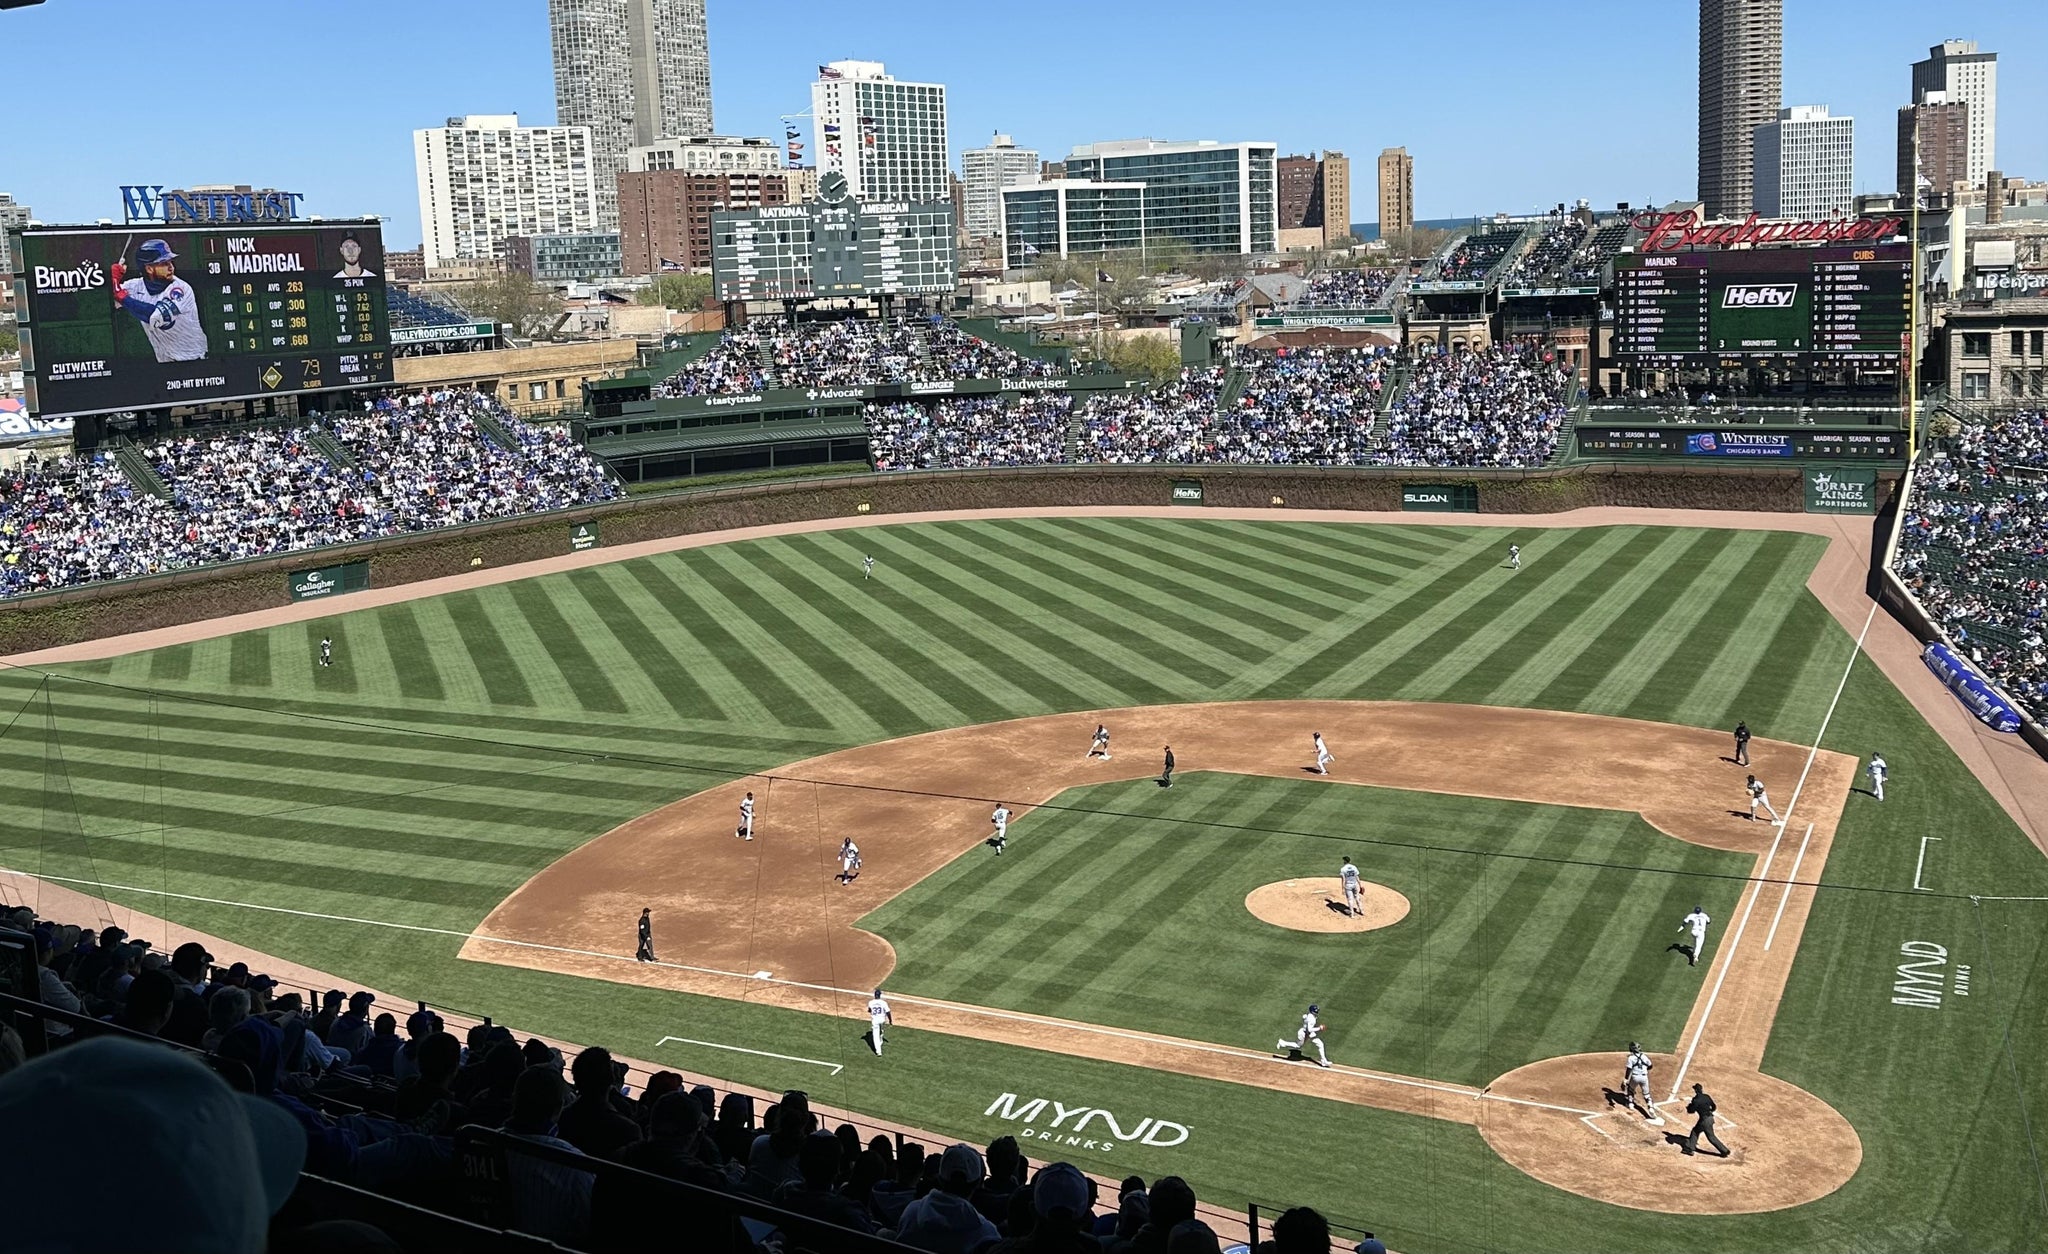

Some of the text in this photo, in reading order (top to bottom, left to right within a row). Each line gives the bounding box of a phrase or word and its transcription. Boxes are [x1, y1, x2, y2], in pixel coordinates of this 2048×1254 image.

[119, 186, 304, 221] WINTRUST
[860, 203, 909, 214] AMERICAN
[760, 207, 809, 218] NATIONAL
[1632, 210, 1904, 251] Budweiser
[227, 238, 255, 252] NICK
[1853, 251, 1875, 260] CUBS
[229, 253, 304, 274] MADRIGAL
[1645, 257, 1677, 267] MARLINS
[209, 263, 220, 274] 3B
[34, 260, 104, 290] Binny's
[222, 284, 252, 294] AB 19
[286, 282, 303, 292] .263
[357, 293, 367, 301] 0-3
[1728, 288, 1791, 306] Hefty
[224, 302, 252, 312] HR 0
[269, 299, 305, 310] OBP .300
[224, 320, 254, 330] RBI 4
[271, 317, 306, 328] SLG .368
[337, 335, 352, 343] WHIP
[390, 326, 477, 341] RIGLEYROOFTOPS.COM
[250, 338, 255, 349] 3
[273, 335, 308, 346] OPS .668
[1794, 339, 1800, 347] 4
[340, 355, 358, 364] PITCH
[52, 361, 104, 374] CUTWATER
[340, 364, 360, 373] BREAK
[167, 377, 225, 390] 2ND-HIT BY PITCH
[911, 381, 955, 390] GRAINGER
[1000, 378, 1068, 390] Budweiser
[820, 388, 863, 398] Advocate
[713, 394, 762, 406] tastytrade
[1721, 432, 1787, 444] WINTRUST
[1816, 481, 1865, 492] DRAFT
[1176, 489, 1200, 498] Hefty
[1404, 494, 1447, 502] SLOAN
[1821, 491, 1863, 500] KINGS
[572, 535, 595, 544] Benjamin
[296, 580, 335, 591] Gallagher
[301, 588, 330, 597] INSURANCE
[1891, 941, 1948, 1009] MYND
[1954, 964, 1971, 996] DRINKS
[984, 1092, 1190, 1147] MYND
[1021, 1128, 1114, 1151] DRINKS
